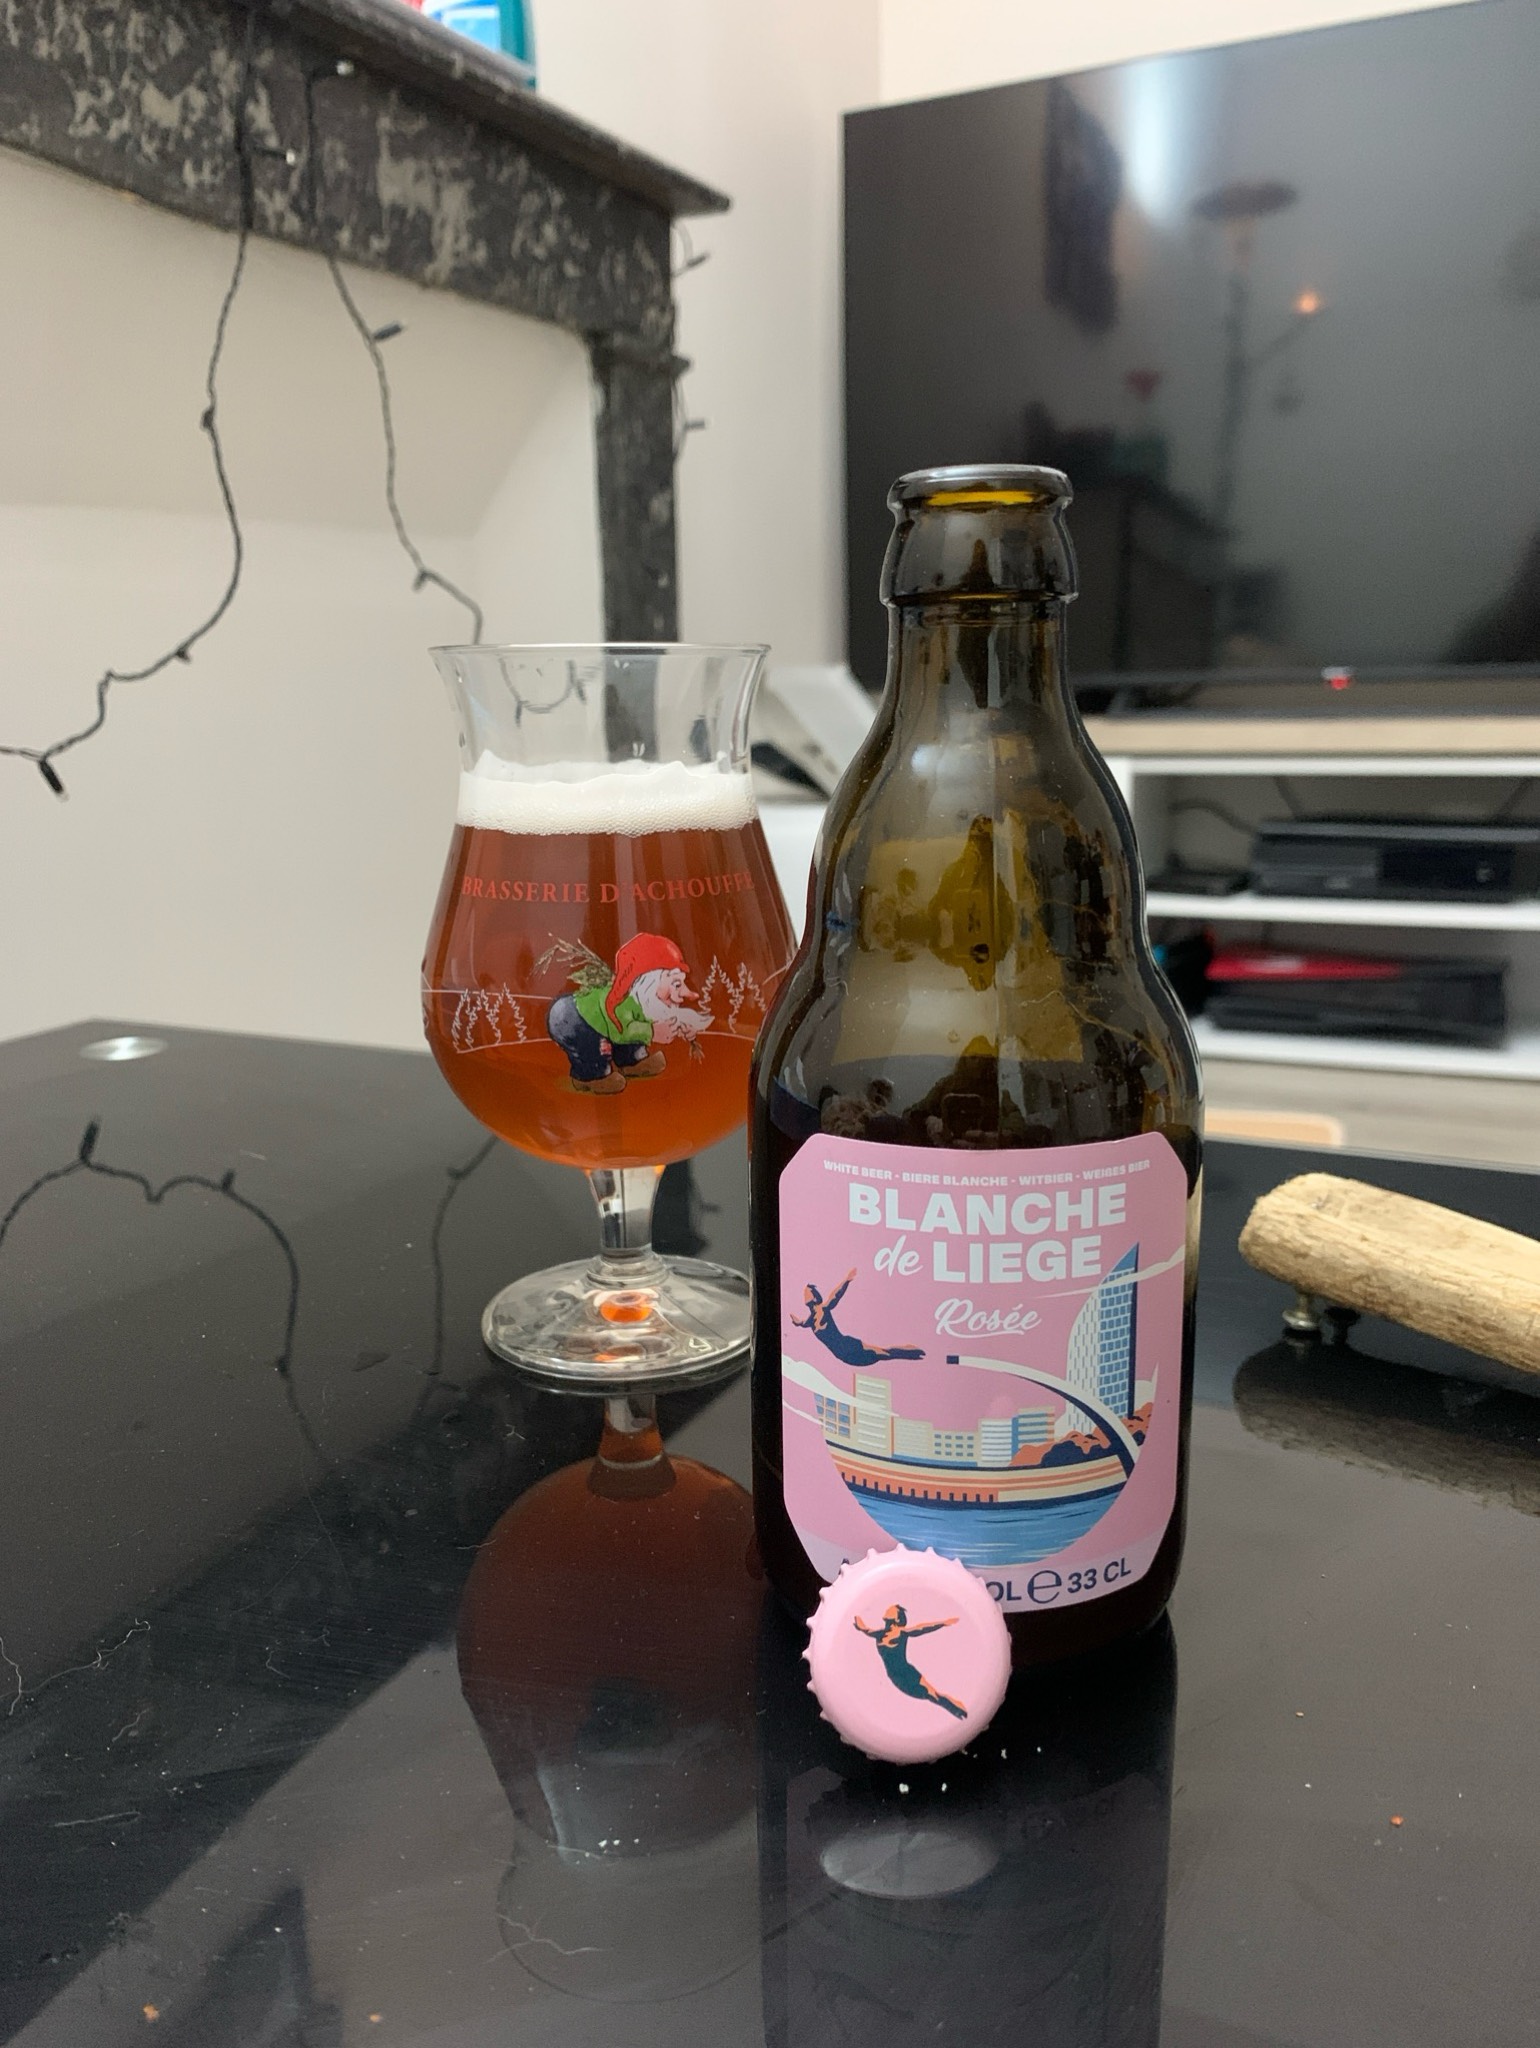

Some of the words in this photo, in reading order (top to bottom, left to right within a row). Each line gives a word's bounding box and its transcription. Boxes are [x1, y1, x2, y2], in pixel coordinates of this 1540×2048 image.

[462, 876, 590, 903] BRASSERIE
[823, 1159, 859, 1176] WHITE
[861, 1167, 892, 1180] BEER
[902, 1172, 940, 1184] BIERE
[943, 1174, 1008, 1187] BLANCHE
[1018, 1172, 1073, 1186] WITBIER
[1128, 1159, 1150, 1173] BIER
[848, 1182, 1127, 1235] BLANCHE
[874, 1234, 923, 1277] de
[933, 1235, 1101, 1284] LIEGE
[934, 1298, 1042, 1339] Rosée
[1067, 1568, 1097, 1594] 33
[1103, 1557, 1132, 1583] CL
